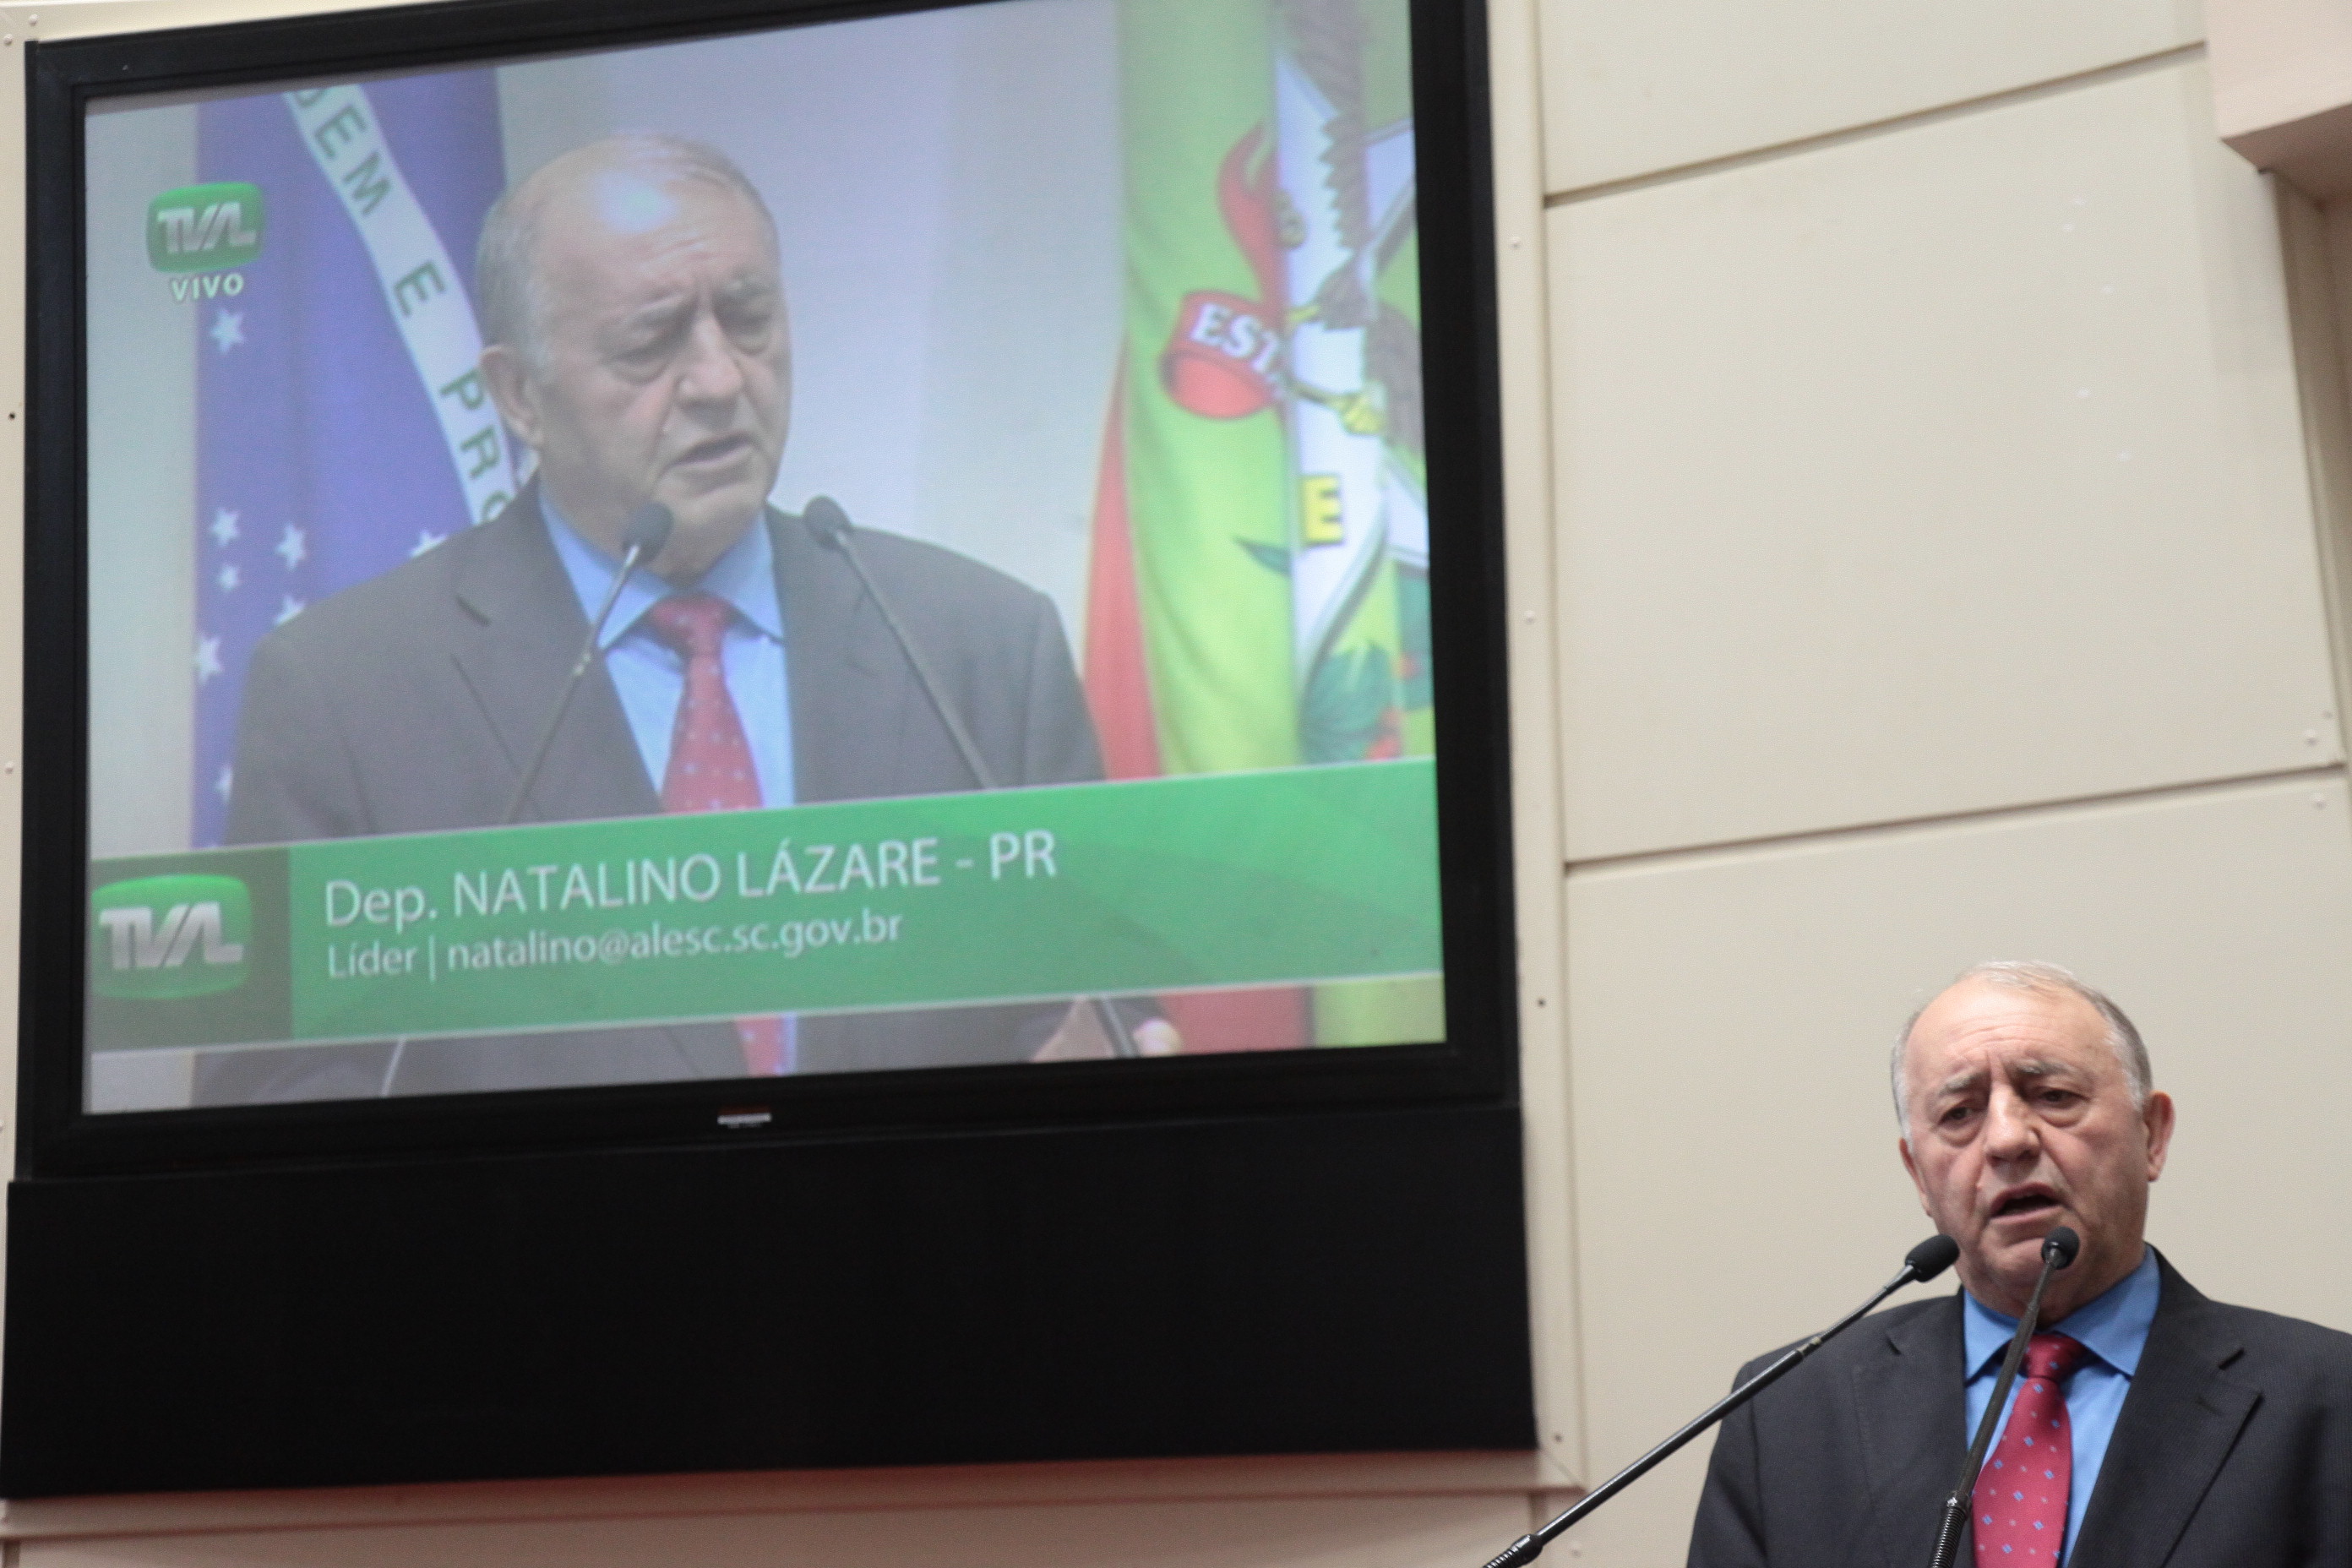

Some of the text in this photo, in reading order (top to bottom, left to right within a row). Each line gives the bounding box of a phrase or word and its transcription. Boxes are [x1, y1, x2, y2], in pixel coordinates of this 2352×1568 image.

[172, 273, 244, 301] VIVO
[395, 260, 446, 317] E
[325, 830, 1058, 934] Dep. NATALINO LÁZARE - PR
[328, 939, 417, 979] Líder
[447, 907, 901, 971] natalino@alesc.sc.gov.br
